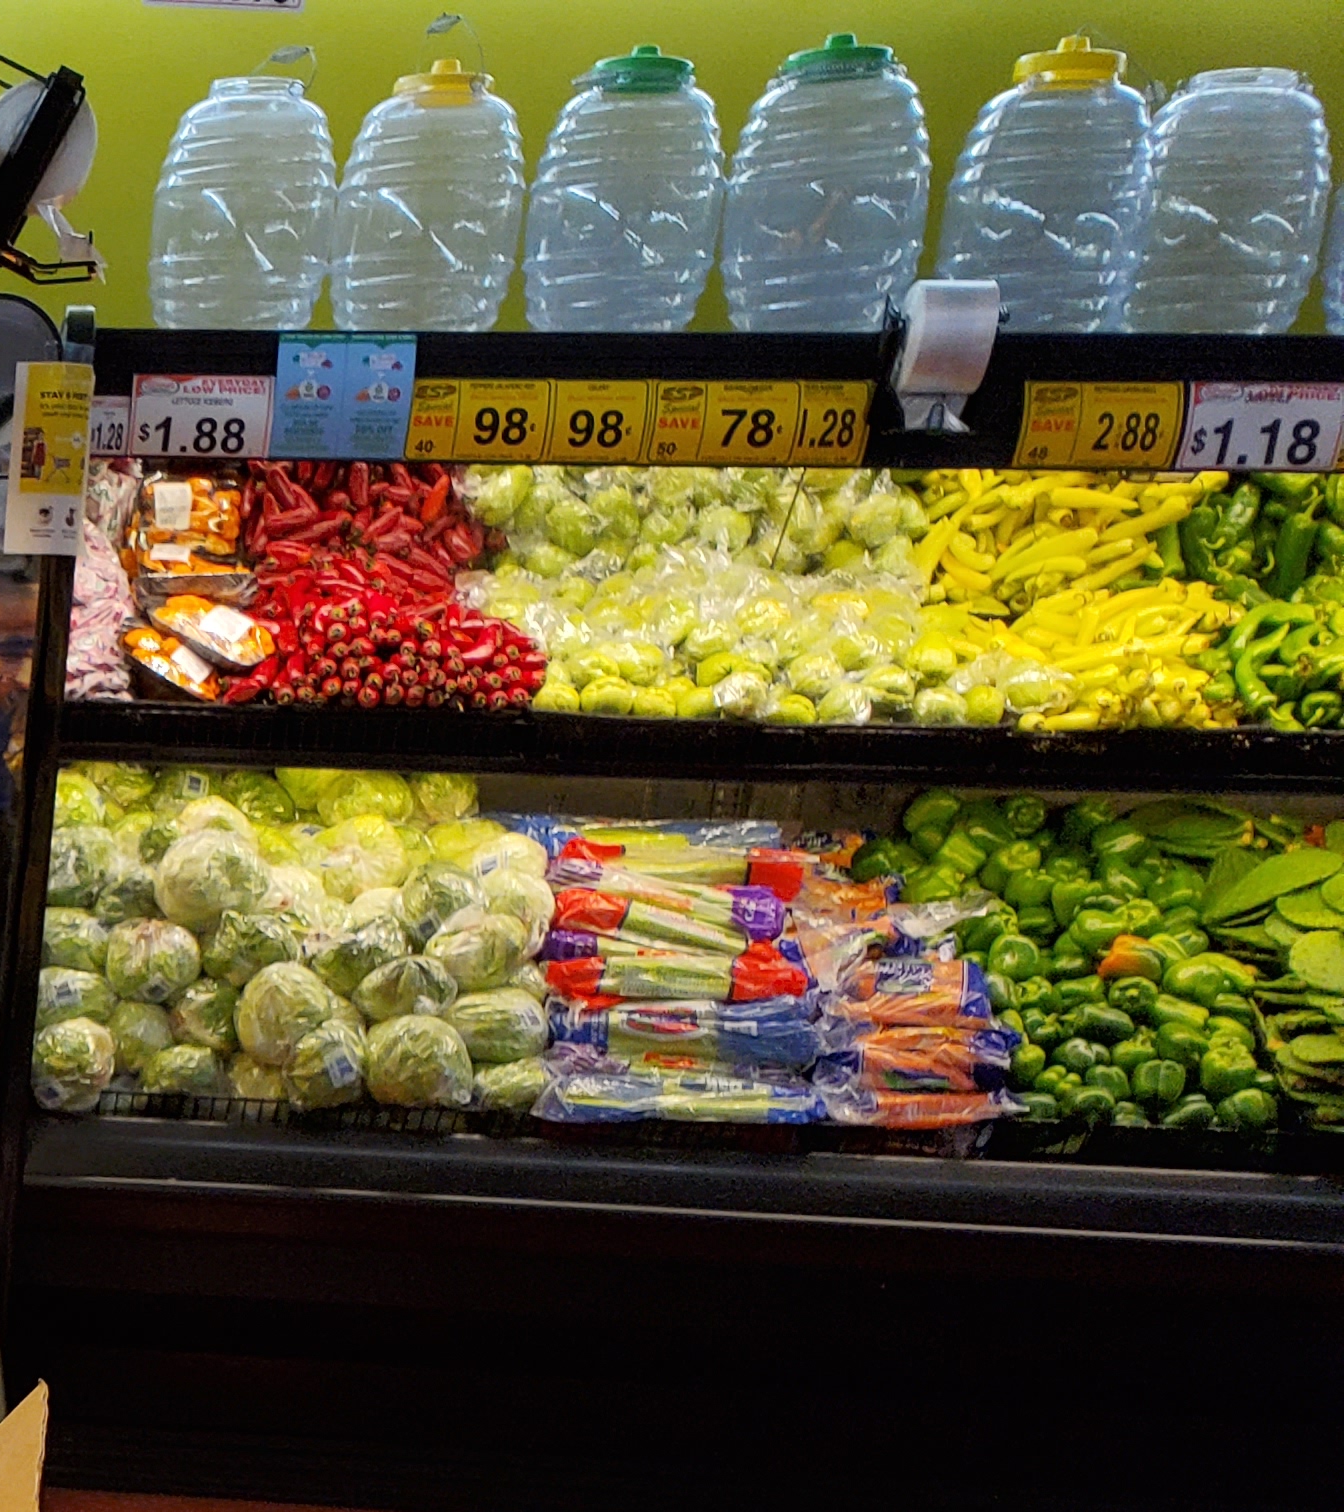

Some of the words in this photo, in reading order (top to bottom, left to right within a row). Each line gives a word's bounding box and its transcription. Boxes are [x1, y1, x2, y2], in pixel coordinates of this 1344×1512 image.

[413, 415, 454, 427] SAVE
[659, 417, 700, 429] SAVE
[138, 416, 246, 454] $1.88
[1191, 418, 1321, 466] $1.18
